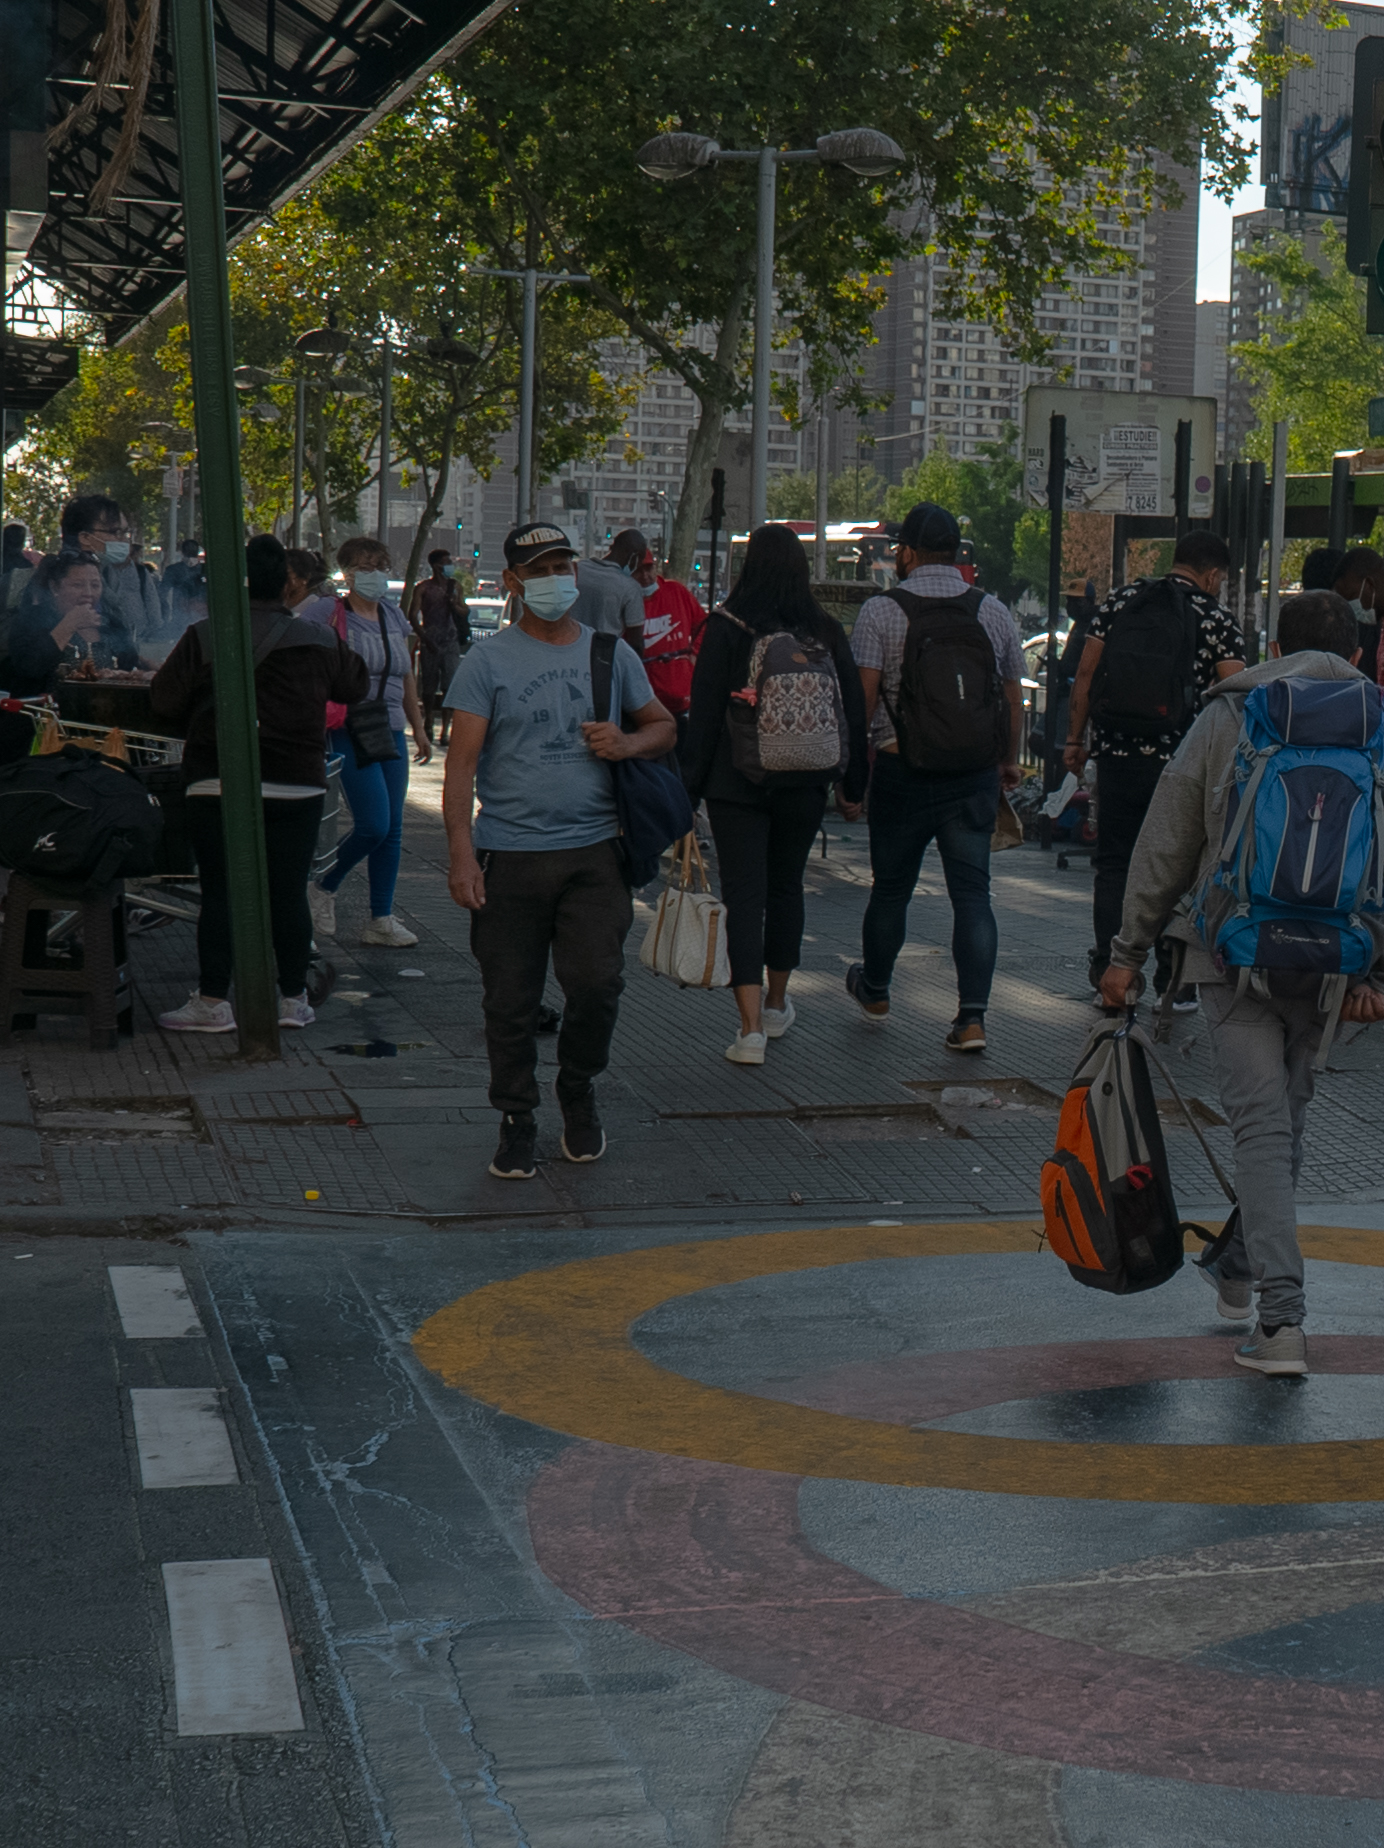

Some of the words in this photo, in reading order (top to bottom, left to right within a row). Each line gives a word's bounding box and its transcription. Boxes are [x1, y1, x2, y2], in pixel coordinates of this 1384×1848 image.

[1136, 496, 1158, 510] 8245
[666, 631, 684, 642] AIR
[517, 668, 580, 704] PORTMAN
[532, 708, 550, 724] 19
